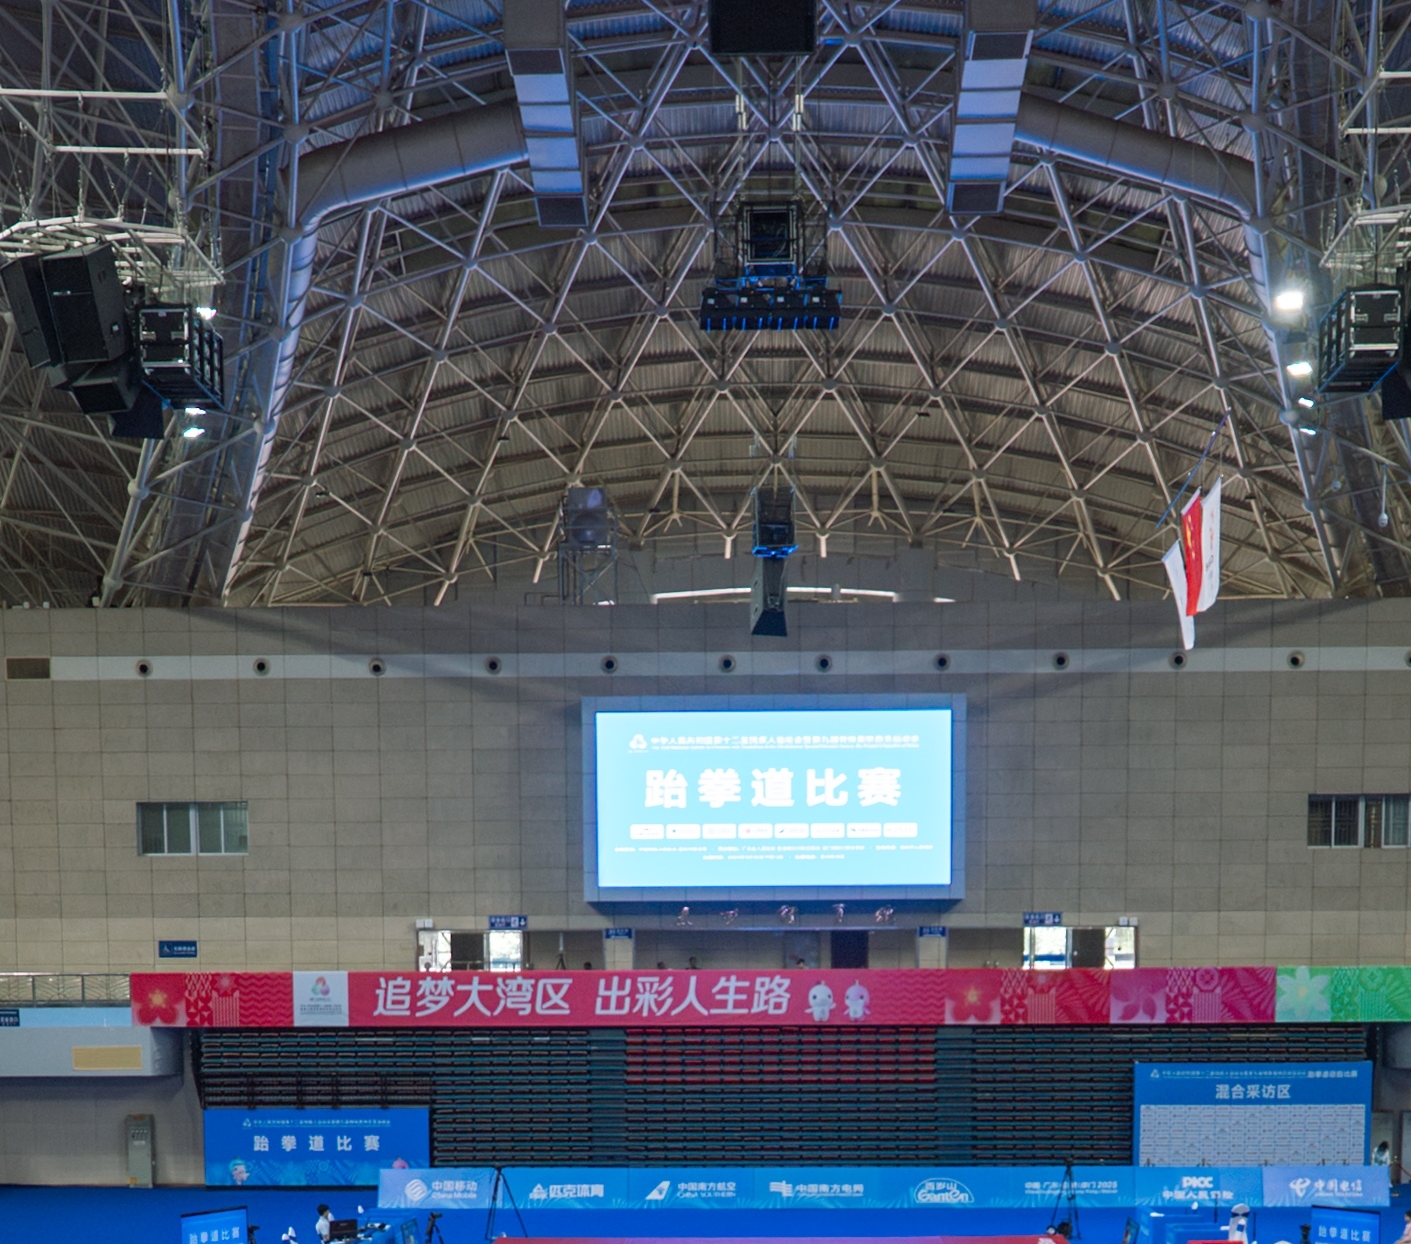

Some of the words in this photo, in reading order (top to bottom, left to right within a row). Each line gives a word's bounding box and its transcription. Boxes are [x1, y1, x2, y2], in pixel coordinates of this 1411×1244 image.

[644, 767, 902, 809] 跆拳道比赛
[374, 975, 573, 1018] 追梦大湾区
[594, 974, 791, 1016] 出彩人生路
[1215, 1084, 1291, 1099] 混合采访区
[253, 1135, 380, 1152] 跆拳道比赛
[432, 1180, 478, 1191] 中国移动
[677, 1181, 736, 1191] 中国南方航空
[796, 1183, 864, 1194] 中国南方电网
[1182, 1176, 1213, 1188] PICC
[1314, 1179, 1362, 1192] 中国电信
[549, 1184, 604, 1198] 匹克体育
